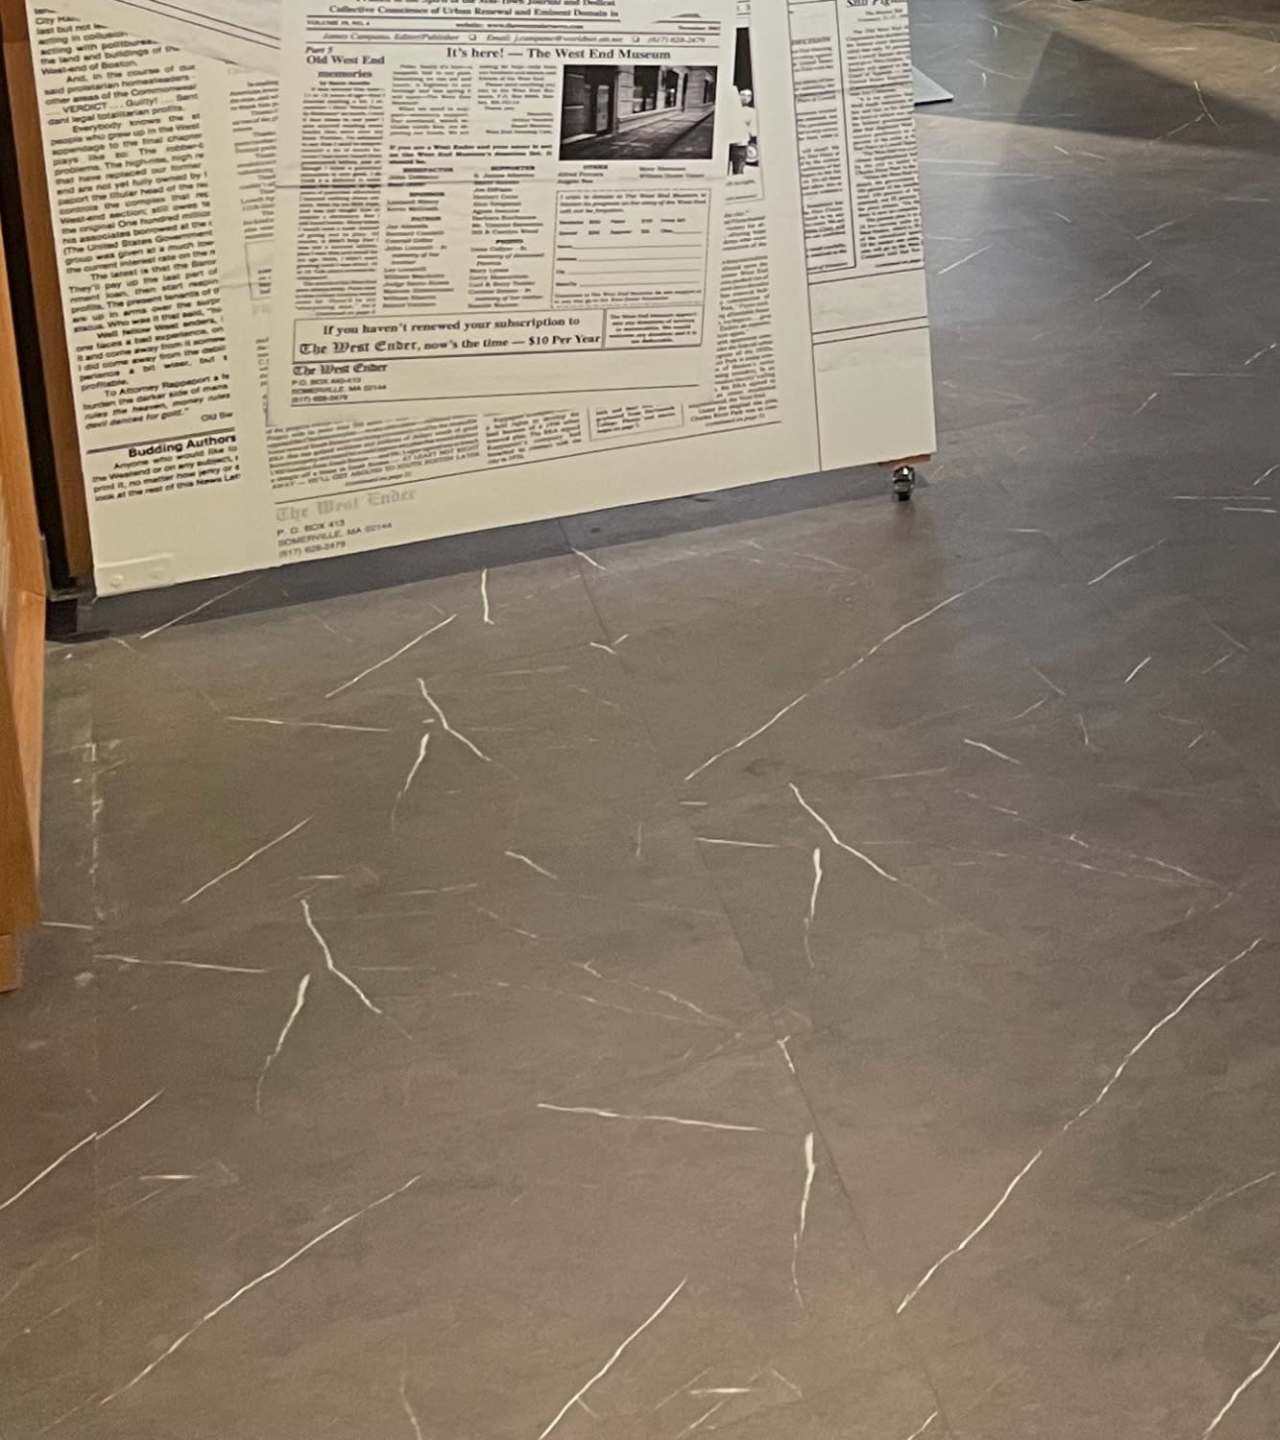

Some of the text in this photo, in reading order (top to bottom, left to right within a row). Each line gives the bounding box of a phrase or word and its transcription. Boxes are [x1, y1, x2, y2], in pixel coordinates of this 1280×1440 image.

[305, 54, 385, 64] Old West End
[446, 46, 670, 59] It’s here! The West End Museum
[323, 316, 580, 338] If you haven’t renewed your subscription to
[299, 334, 601, 355] The West Ender, now’s the time $10 Per Year
[128, 434, 237, 458] Budding Authors
